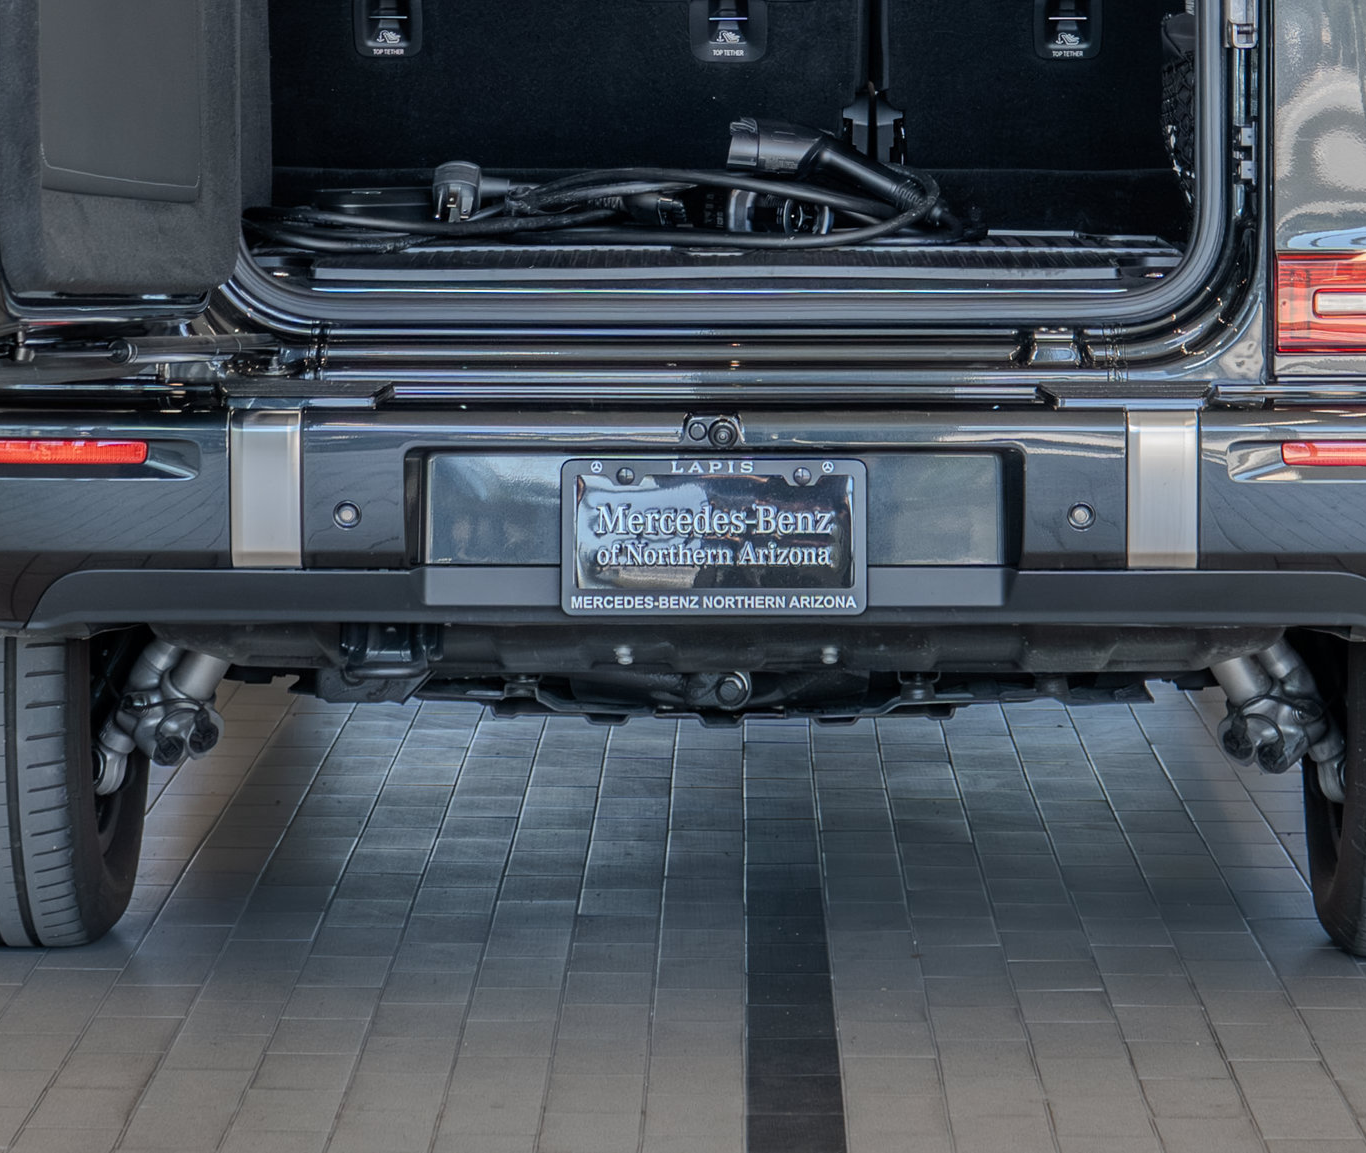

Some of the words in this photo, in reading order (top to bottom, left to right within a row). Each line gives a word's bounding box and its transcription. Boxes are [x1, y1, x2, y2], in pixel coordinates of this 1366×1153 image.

[671, 460, 754, 473] LAPIS
[596, 505, 832, 535] Mercedes-Benz
[597, 543, 620, 566] of
[626, 543, 733, 566] Northern
[739, 541, 831, 566] Arizona
[571, 596, 699, 609] MERCEDES-BENZ
[703, 596, 786, 609] NORTHERN
[789, 596, 857, 609] ARIZONA
